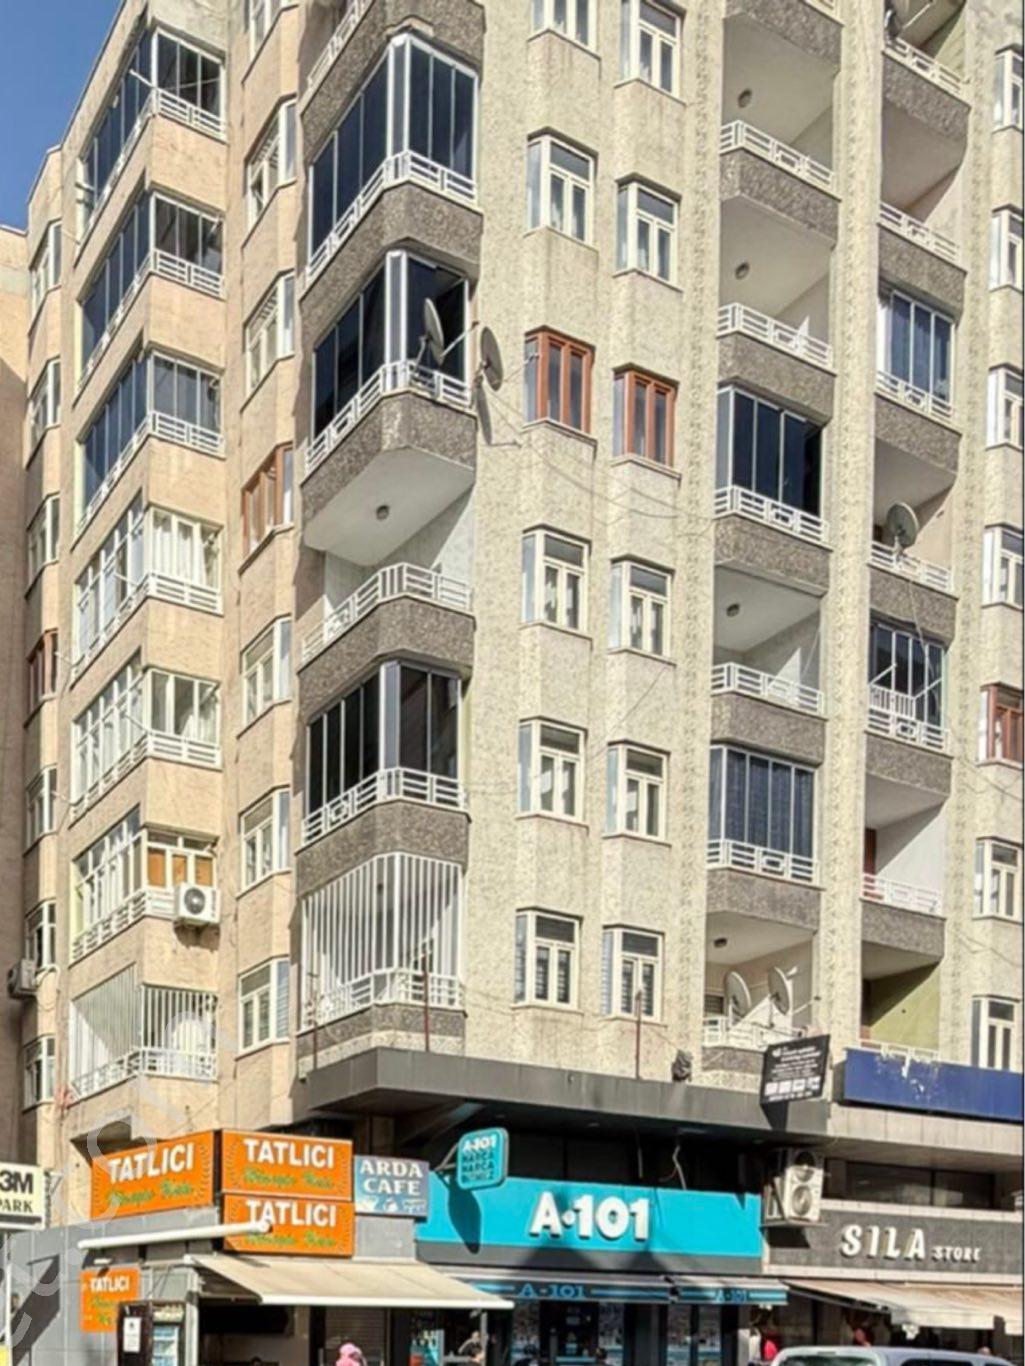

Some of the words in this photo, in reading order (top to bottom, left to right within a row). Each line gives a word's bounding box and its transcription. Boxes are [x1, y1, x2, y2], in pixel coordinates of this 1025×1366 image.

[108, 1142, 194, 1184] TATLICI
[243, 1138, 335, 1169] TATLICI
[360, 1159, 423, 1178] ARDA
[363, 1177, 421, 1196] CAFE
[246, 1199, 337, 1227] TATLICI
[840, 1223, 927, 1260] SILA
[90, 1275, 130, 1293] TATLICI
